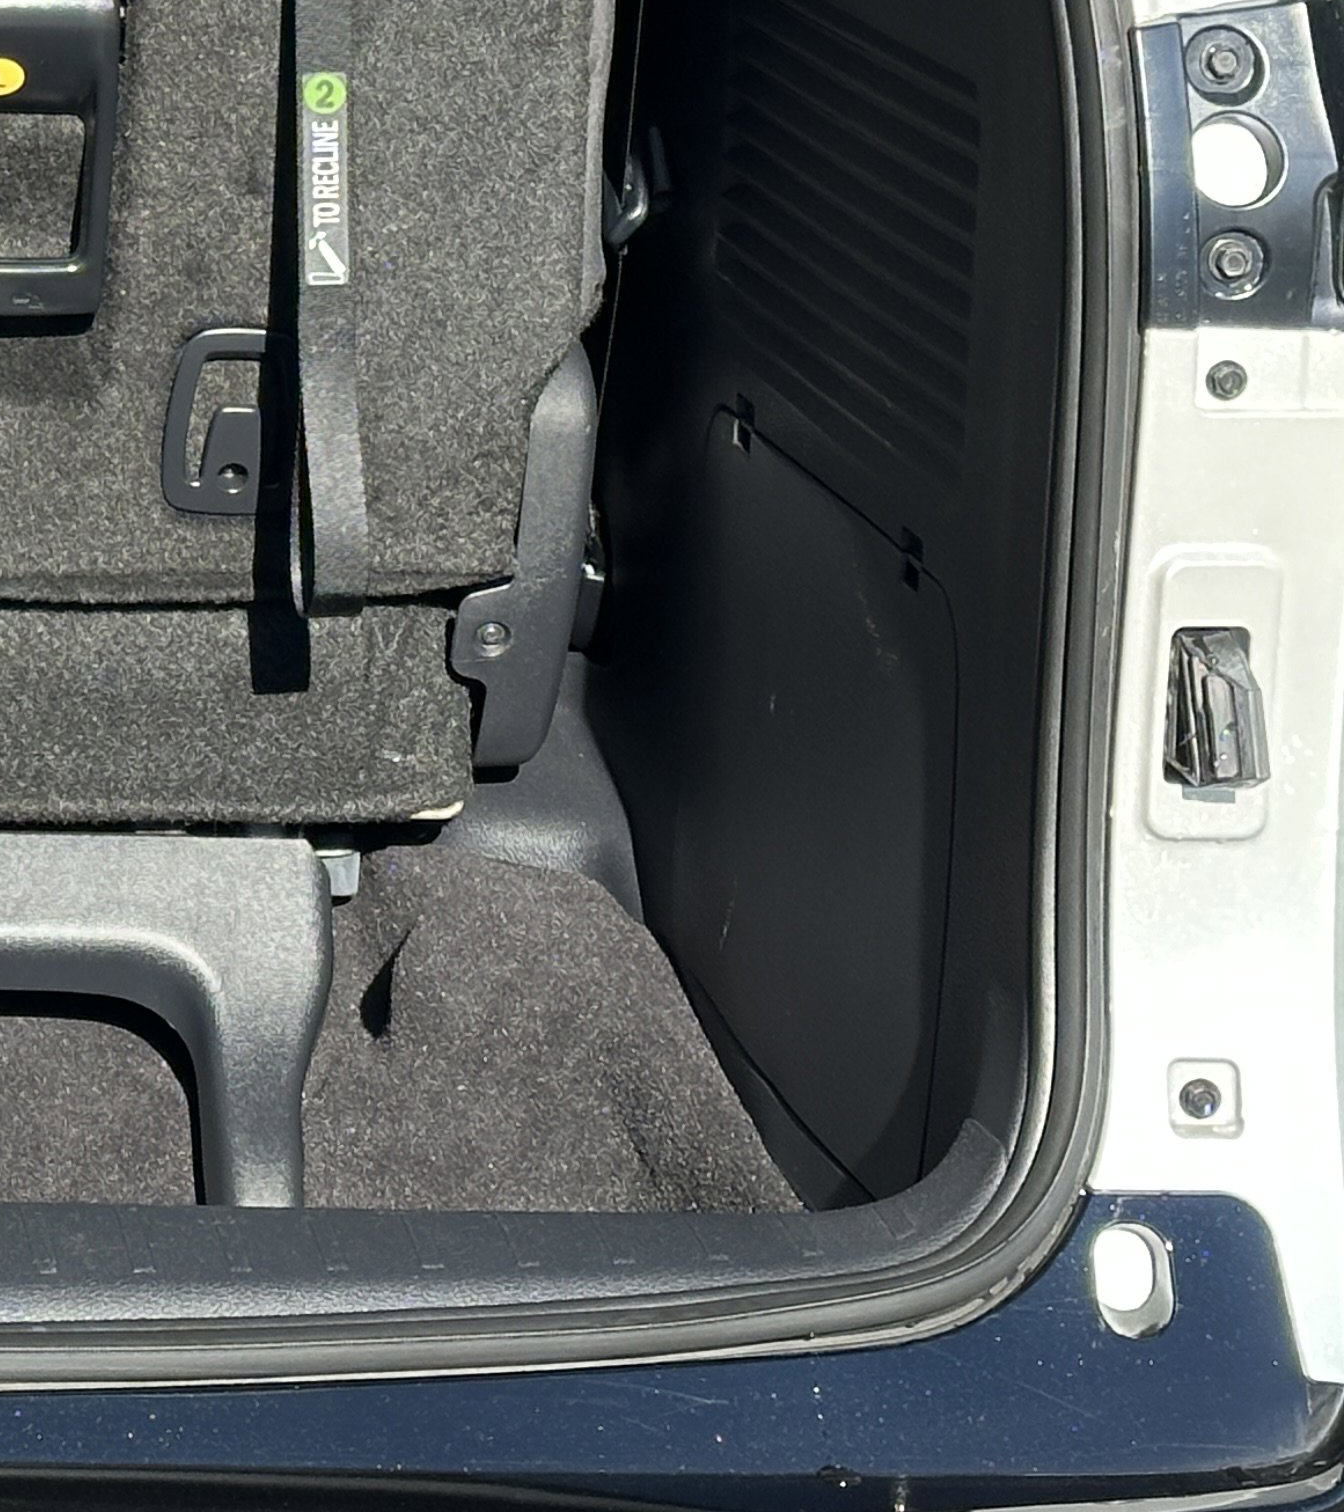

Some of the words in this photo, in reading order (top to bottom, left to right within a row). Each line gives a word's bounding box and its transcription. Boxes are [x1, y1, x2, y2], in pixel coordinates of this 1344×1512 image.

[315, 79, 335, 109] 2
[311, 120, 340, 199] RECLINE
[312, 202, 341, 227] TO
